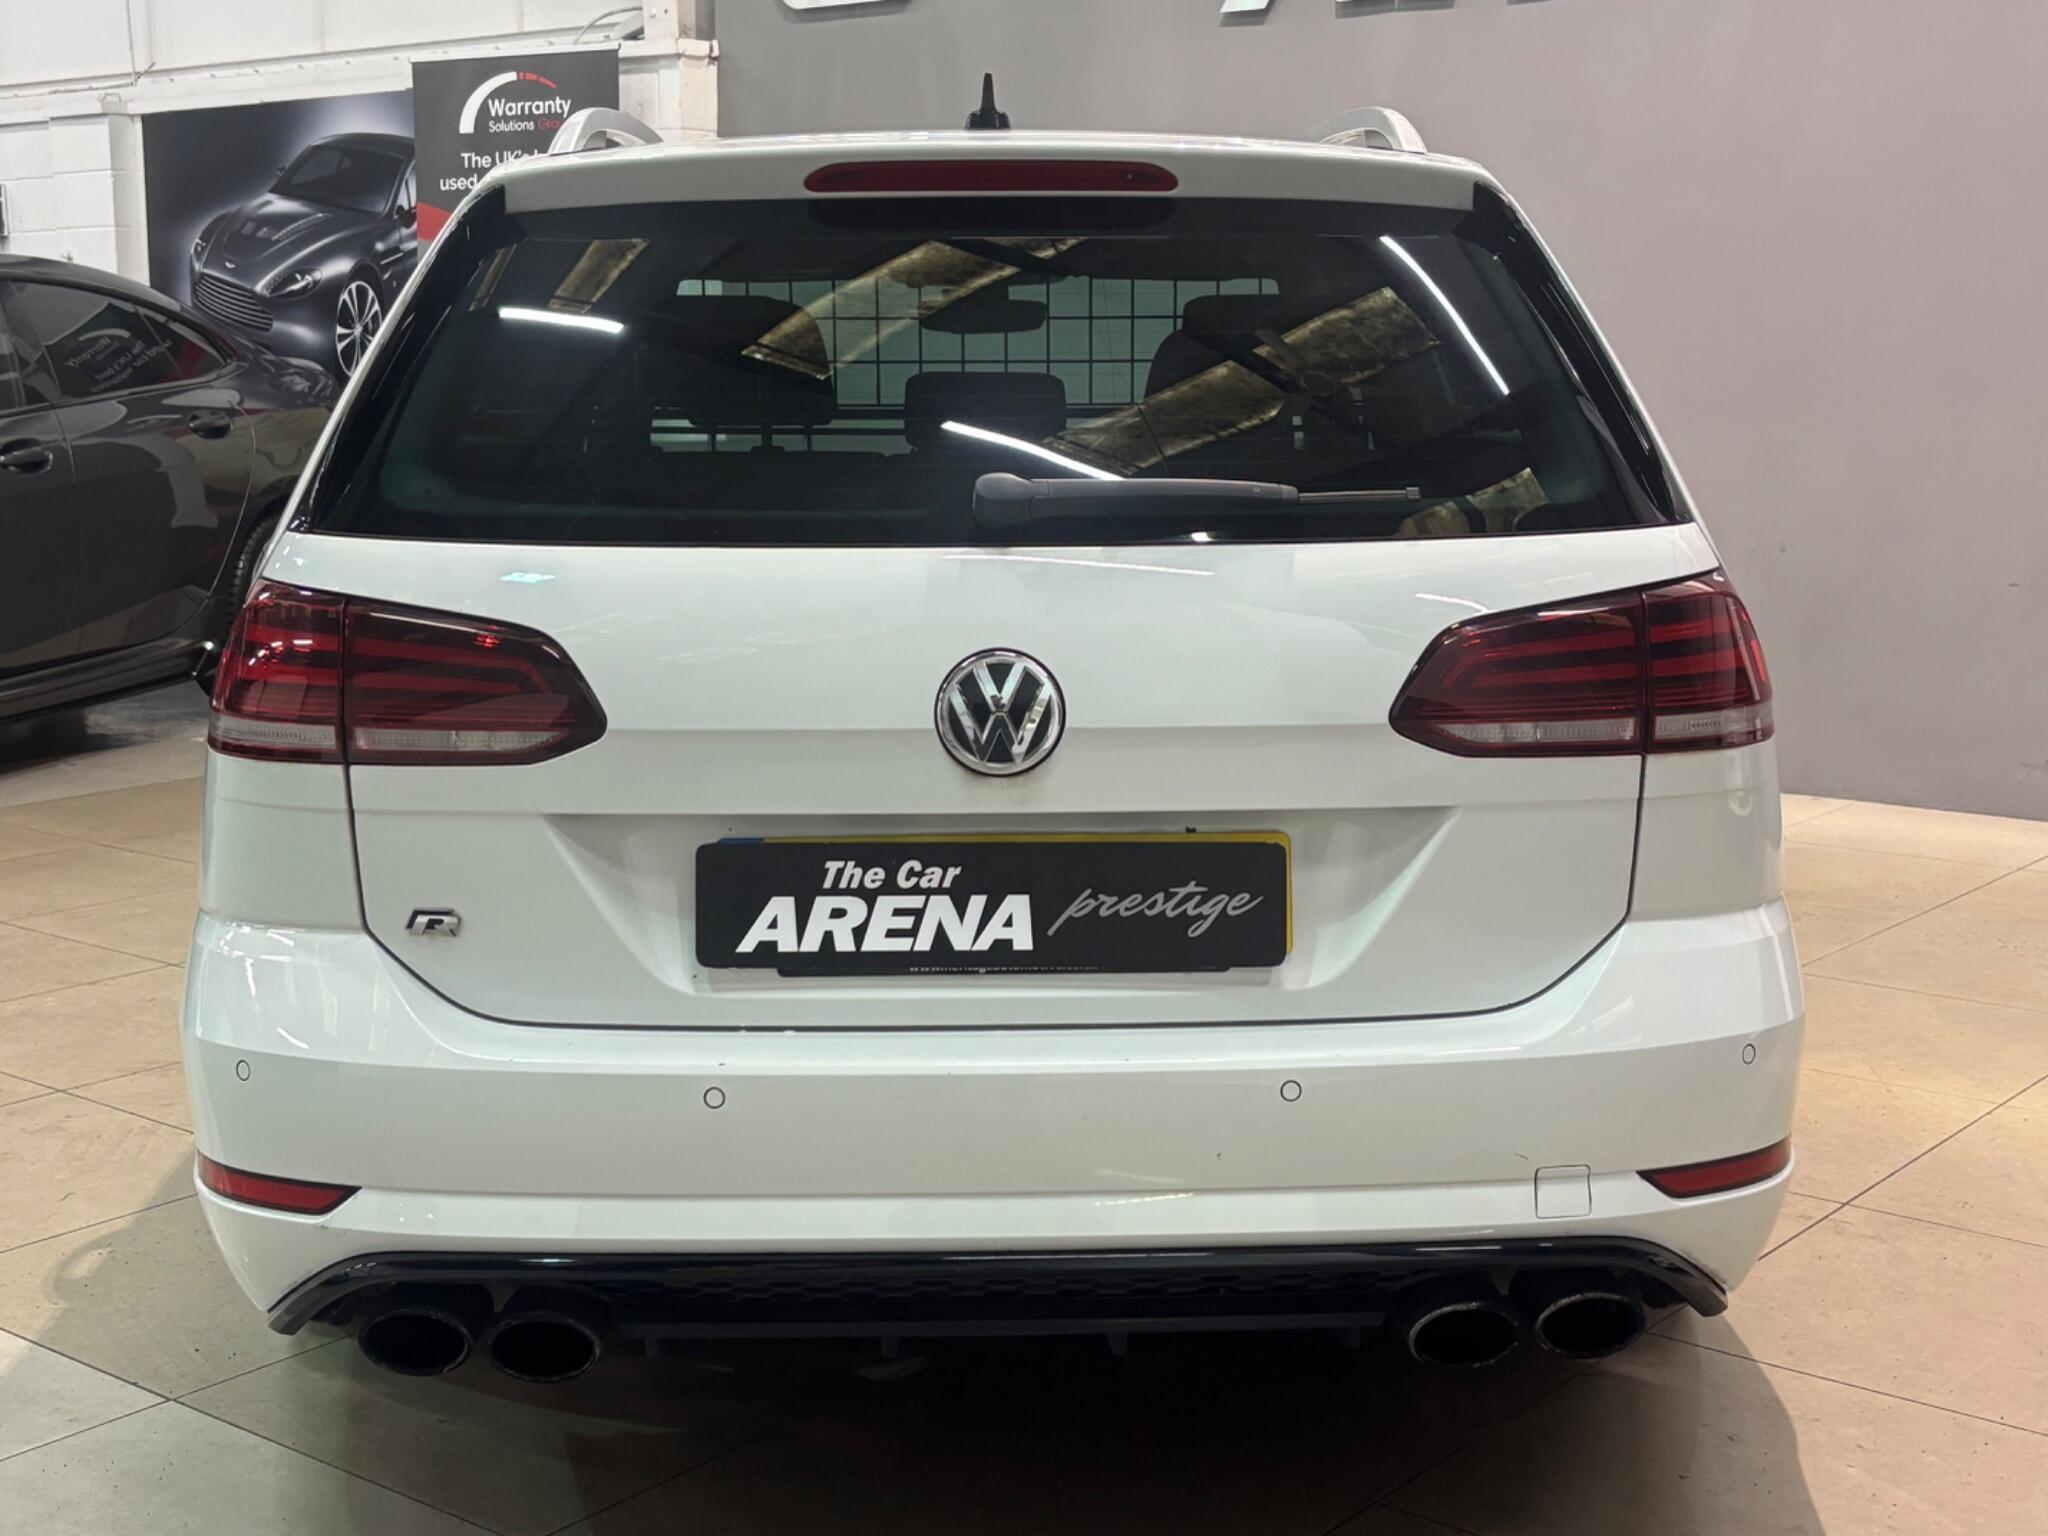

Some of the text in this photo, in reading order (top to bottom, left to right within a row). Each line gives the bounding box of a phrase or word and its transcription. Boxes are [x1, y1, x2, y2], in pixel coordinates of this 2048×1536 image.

[488, 95, 572, 118] Warranty
[488, 119, 535, 133] Solutions
[460, 152, 492, 169] The
[439, 173, 478, 191] used
[822, 859, 963, 889] The Car
[1046, 880, 1264, 938] prestige
[735, 894, 1034, 953] ARENA
